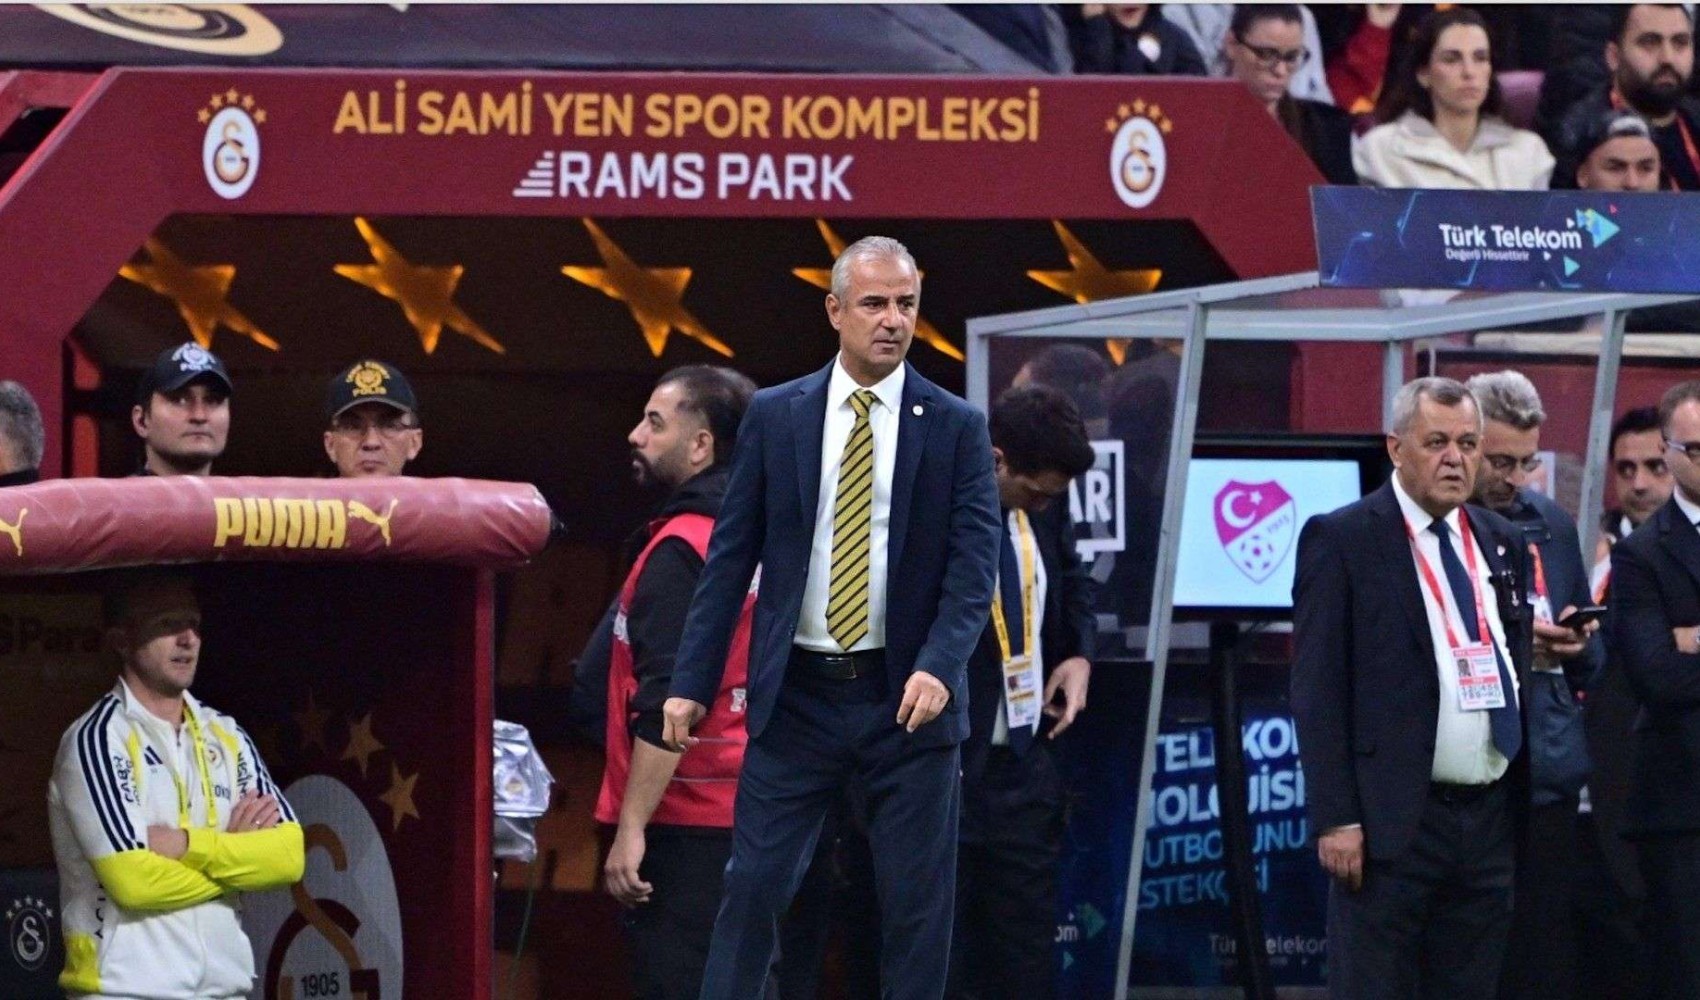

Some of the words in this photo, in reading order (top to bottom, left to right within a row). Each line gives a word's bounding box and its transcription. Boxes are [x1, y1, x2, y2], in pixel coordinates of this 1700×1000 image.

[333, 79, 406, 134] ALİ
[417, 80, 533, 135] SAMİ
[543, 93, 634, 137] YEN
[645, 94, 771, 138] SPOR
[782, 87, 1040, 142] KOMPLEKSİ
[560, 151, 705, 200] RAMS
[718, 153, 854, 200] PARK
[1439, 223, 1487, 247] Türk
[1491, 225, 1582, 249] Telekom
[213, 497, 346, 549] PUMA
[301, 971, 340, 998] 1905
